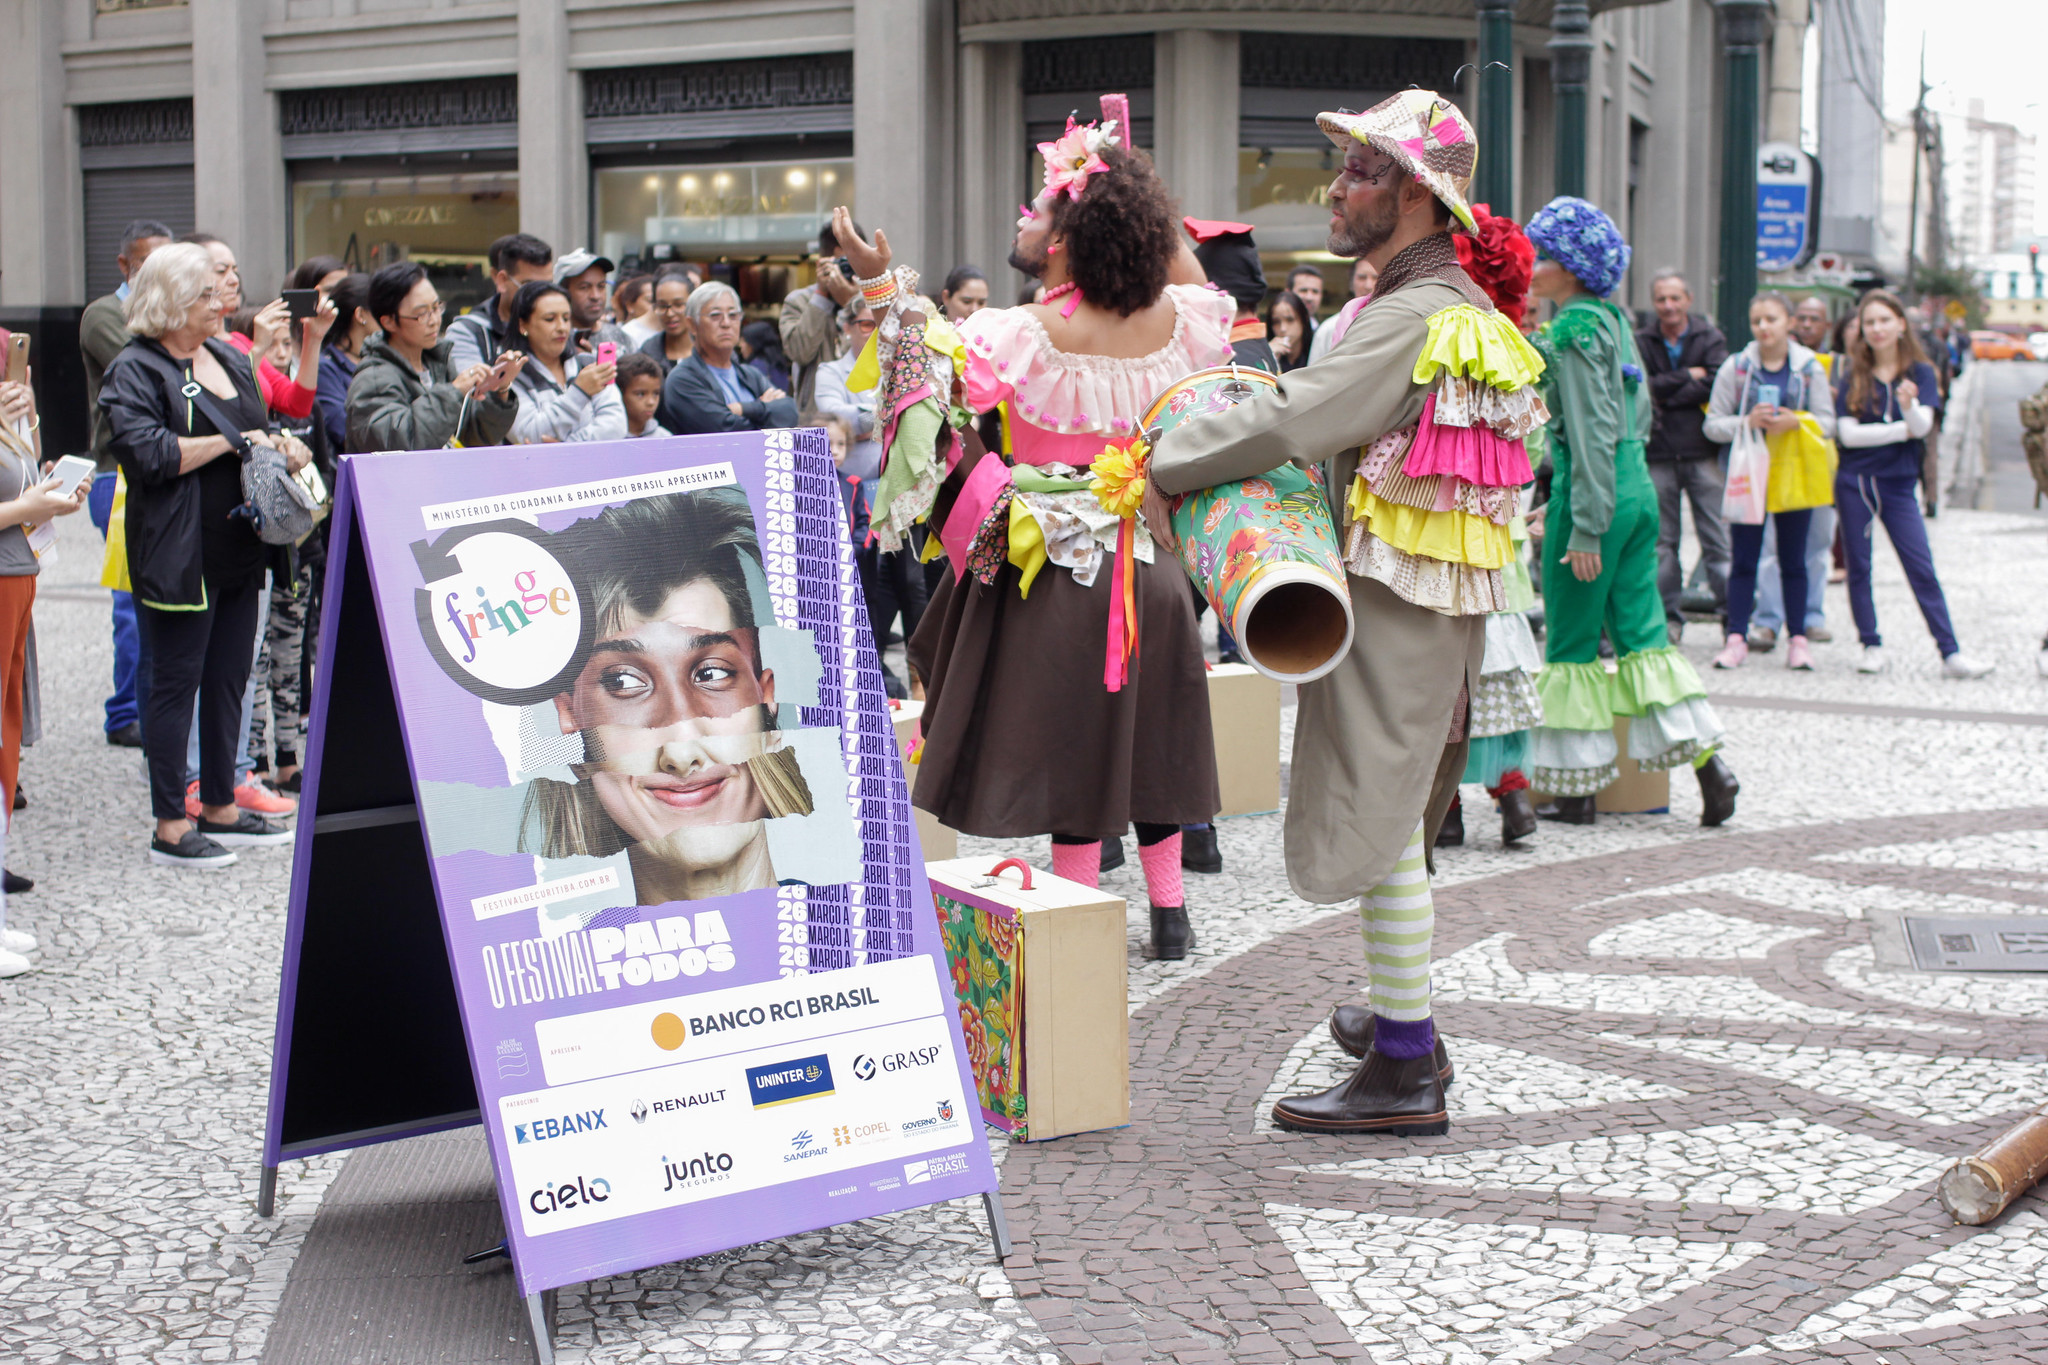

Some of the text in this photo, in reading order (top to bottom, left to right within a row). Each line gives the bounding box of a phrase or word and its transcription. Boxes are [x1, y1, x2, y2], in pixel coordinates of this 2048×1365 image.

[763, 430, 793, 450] 26
[794, 433, 825, 456] MARÇO
[764, 449, 794, 471] 26
[794, 454, 826, 477] MARÇO
[432, 469, 728, 522] MINISTÉRIO DA CIDADANIA & BANCO RCI BRASIL APRESENTAM
[765, 469, 795, 491] 26
[795, 474, 827, 497] MARÇO
[765, 490, 795, 512] 26
[795, 495, 827, 518] MARÇO
[766, 511, 796, 533] 26
[796, 516, 828, 538] MARÇO
[766, 532, 796, 554] 26
[796, 537, 828, 559] MARÇO
[838, 543, 853, 562] 7
[767, 553, 797, 575] 26
[797, 558, 829, 580] MARÇO
[839, 564, 854, 583] 7
[768, 574, 797, 596] 26
[797, 579, 830, 601] MARÇO
[840, 585, 854, 604] 7
[445, 570, 570, 663] fringe
[771, 595, 798, 617] 26
[798, 600, 831, 622] MARÇO
[841, 606, 855, 625] 7
[841, 627, 856, 646] 7
[842, 648, 857, 667] 7
[843, 669, 857, 689] 7
[857, 671, 883, 692] ABRIL
[844, 690, 858, 710] 7
[858, 692, 884, 713] ABRIL
[844, 711, 859, 731] 7
[859, 714, 885, 734] ABRIL
[845, 733, 860, 752] 7
[860, 735, 885, 756] ABRIL
[846, 754, 860, 774] 7
[860, 756, 886, 777] ABRIL
[848, 775, 907, 801] 7 ABRIL 2019
[848, 797, 908, 822] 7 ABRIL 2019
[863, 821, 889, 841] ABRIL
[894, 824, 909, 843] 2019
[863, 842, 910, 866] ABRIL 2019
[864, 864, 911, 887] ABRIL 2019
[482, 875, 611, 912] FESTIVALDECURITIBA.COM.BR
[851, 885, 864, 904] 7
[865, 886, 891, 907] ABRIL
[896, 889, 911, 909] 2019
[777, 900, 807, 922] 26
[808, 903, 841, 925] MARÇO
[851, 906, 866, 926] 7
[866, 908, 892, 929] ABRIL
[897, 911, 913, 930] 2019
[589, 910, 731, 963] PARA
[778, 922, 808, 944] 26
[808, 925, 841, 948] MARÇO
[852, 928, 866, 949] 7
[867, 930, 893, 951] ABRIL
[897, 933, 913, 952] 2019
[482, 930, 602, 1009] O FESTIVAL
[596, 944, 736, 991] TODOS
[779, 945, 809, 967] 26
[809, 948, 842, 969] MARÇO
[689, 987, 880, 1036] BANCO RCI BRASIL
[550, 1045, 581, 1055] APRESENTA
[755, 1068, 805, 1089] UNINTER
[653, 1089, 727, 1114] RENAULT
[532, 1108, 608, 1141] EBANX
[854, 1122, 891, 1138] COPEL
[902, 1117, 937, 1130] GOVERNO
[783, 1146, 828, 1163] SANEPAR
[930, 1159, 969, 1175] BRASIL
[946, 1152, 967, 1161] AMADA
[661, 1152, 733, 1192] junto
[680, 1173, 731, 1189] SEGUROS
[530, 1176, 611, 1215] cielo
[828, 1185, 857, 1198] REALIZAÇÃO
